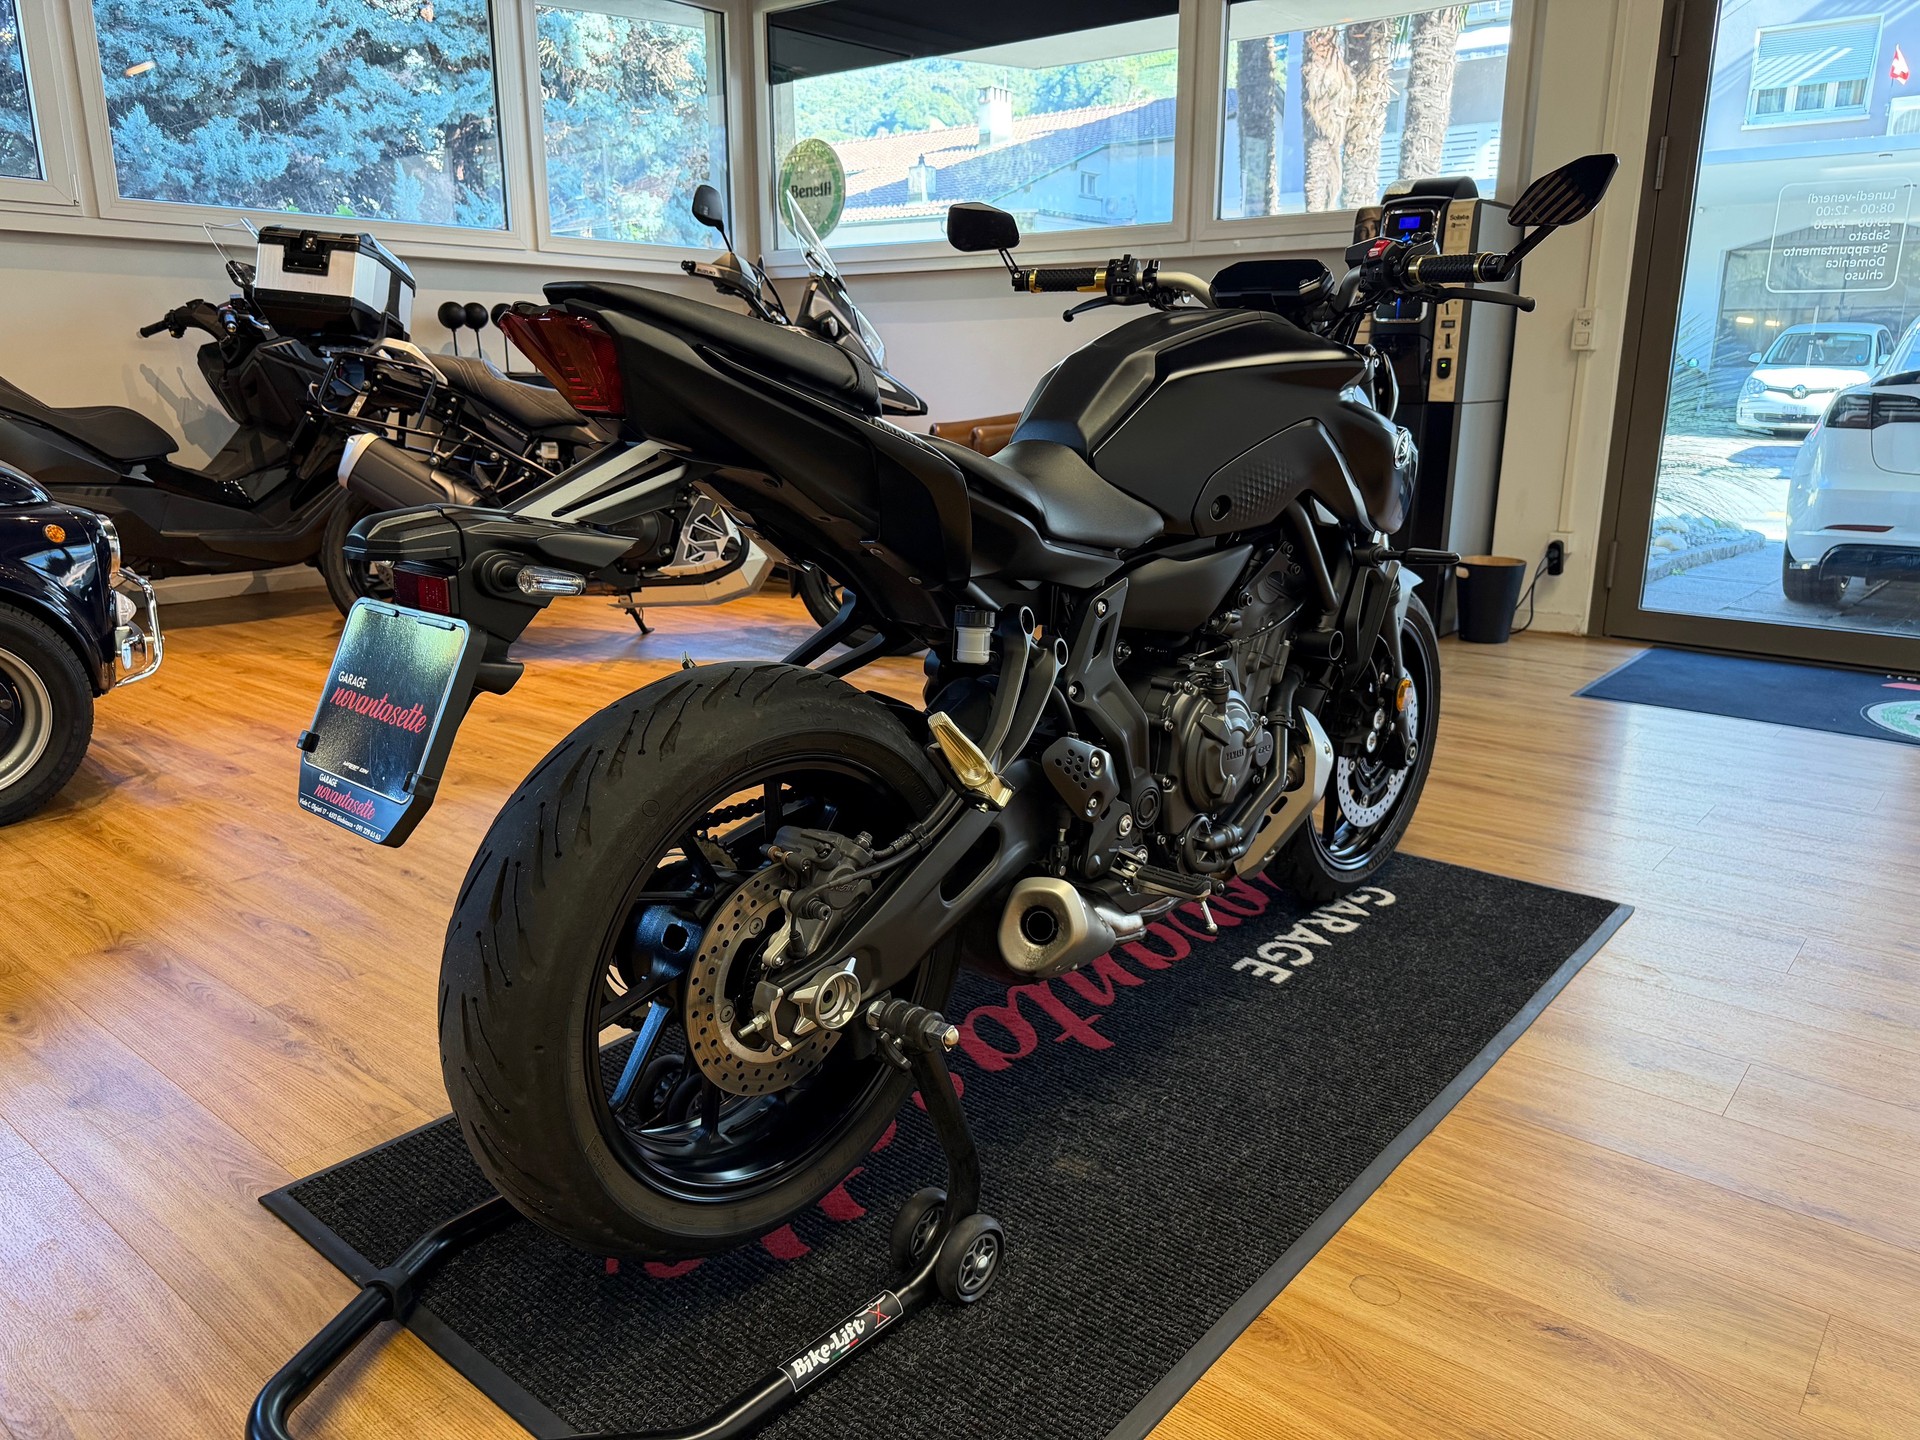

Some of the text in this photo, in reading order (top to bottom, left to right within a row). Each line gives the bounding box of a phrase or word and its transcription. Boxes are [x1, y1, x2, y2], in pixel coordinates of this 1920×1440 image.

[791, 181, 832, 199] Benelli
[338, 670, 368, 690] GARAGE
[329, 685, 427, 735] novantasette
[319, 773, 339, 787] GARAGE
[313, 783, 376, 820] novantasette
[1231, 886, 1397, 984] GARAGE
[791, 1318, 866, 1378] Bike-Lift
